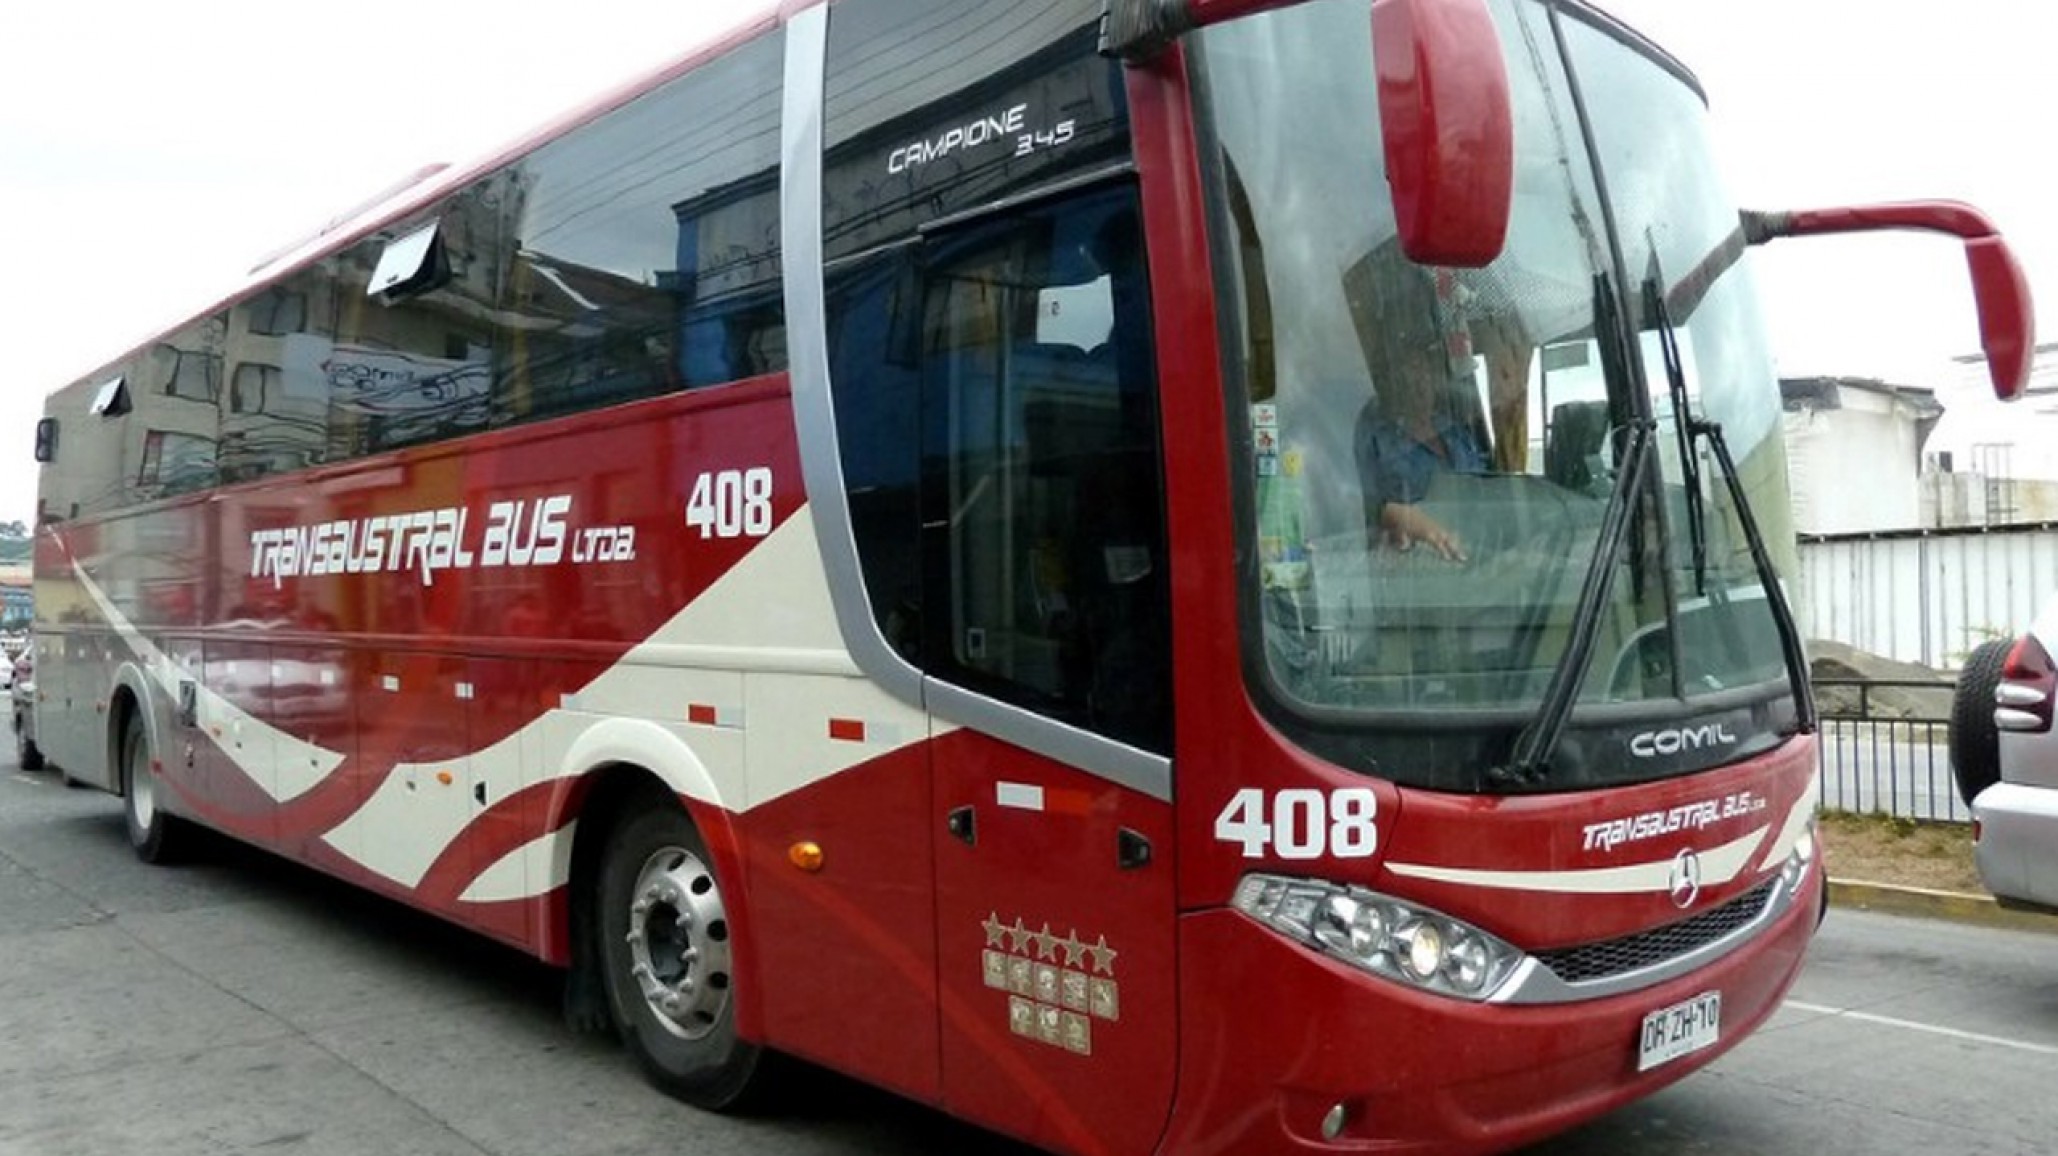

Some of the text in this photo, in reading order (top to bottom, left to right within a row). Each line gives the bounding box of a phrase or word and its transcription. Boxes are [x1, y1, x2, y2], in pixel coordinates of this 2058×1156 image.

[888, 102, 1028, 175] CAMPIONE
[480, 495, 572, 567] BUS
[686, 467, 773, 539] 408
[1630, 723, 1736, 756] COMIL
[1214, 787, 1377, 859] 408
[1722, 791, 1751, 819] BUS
